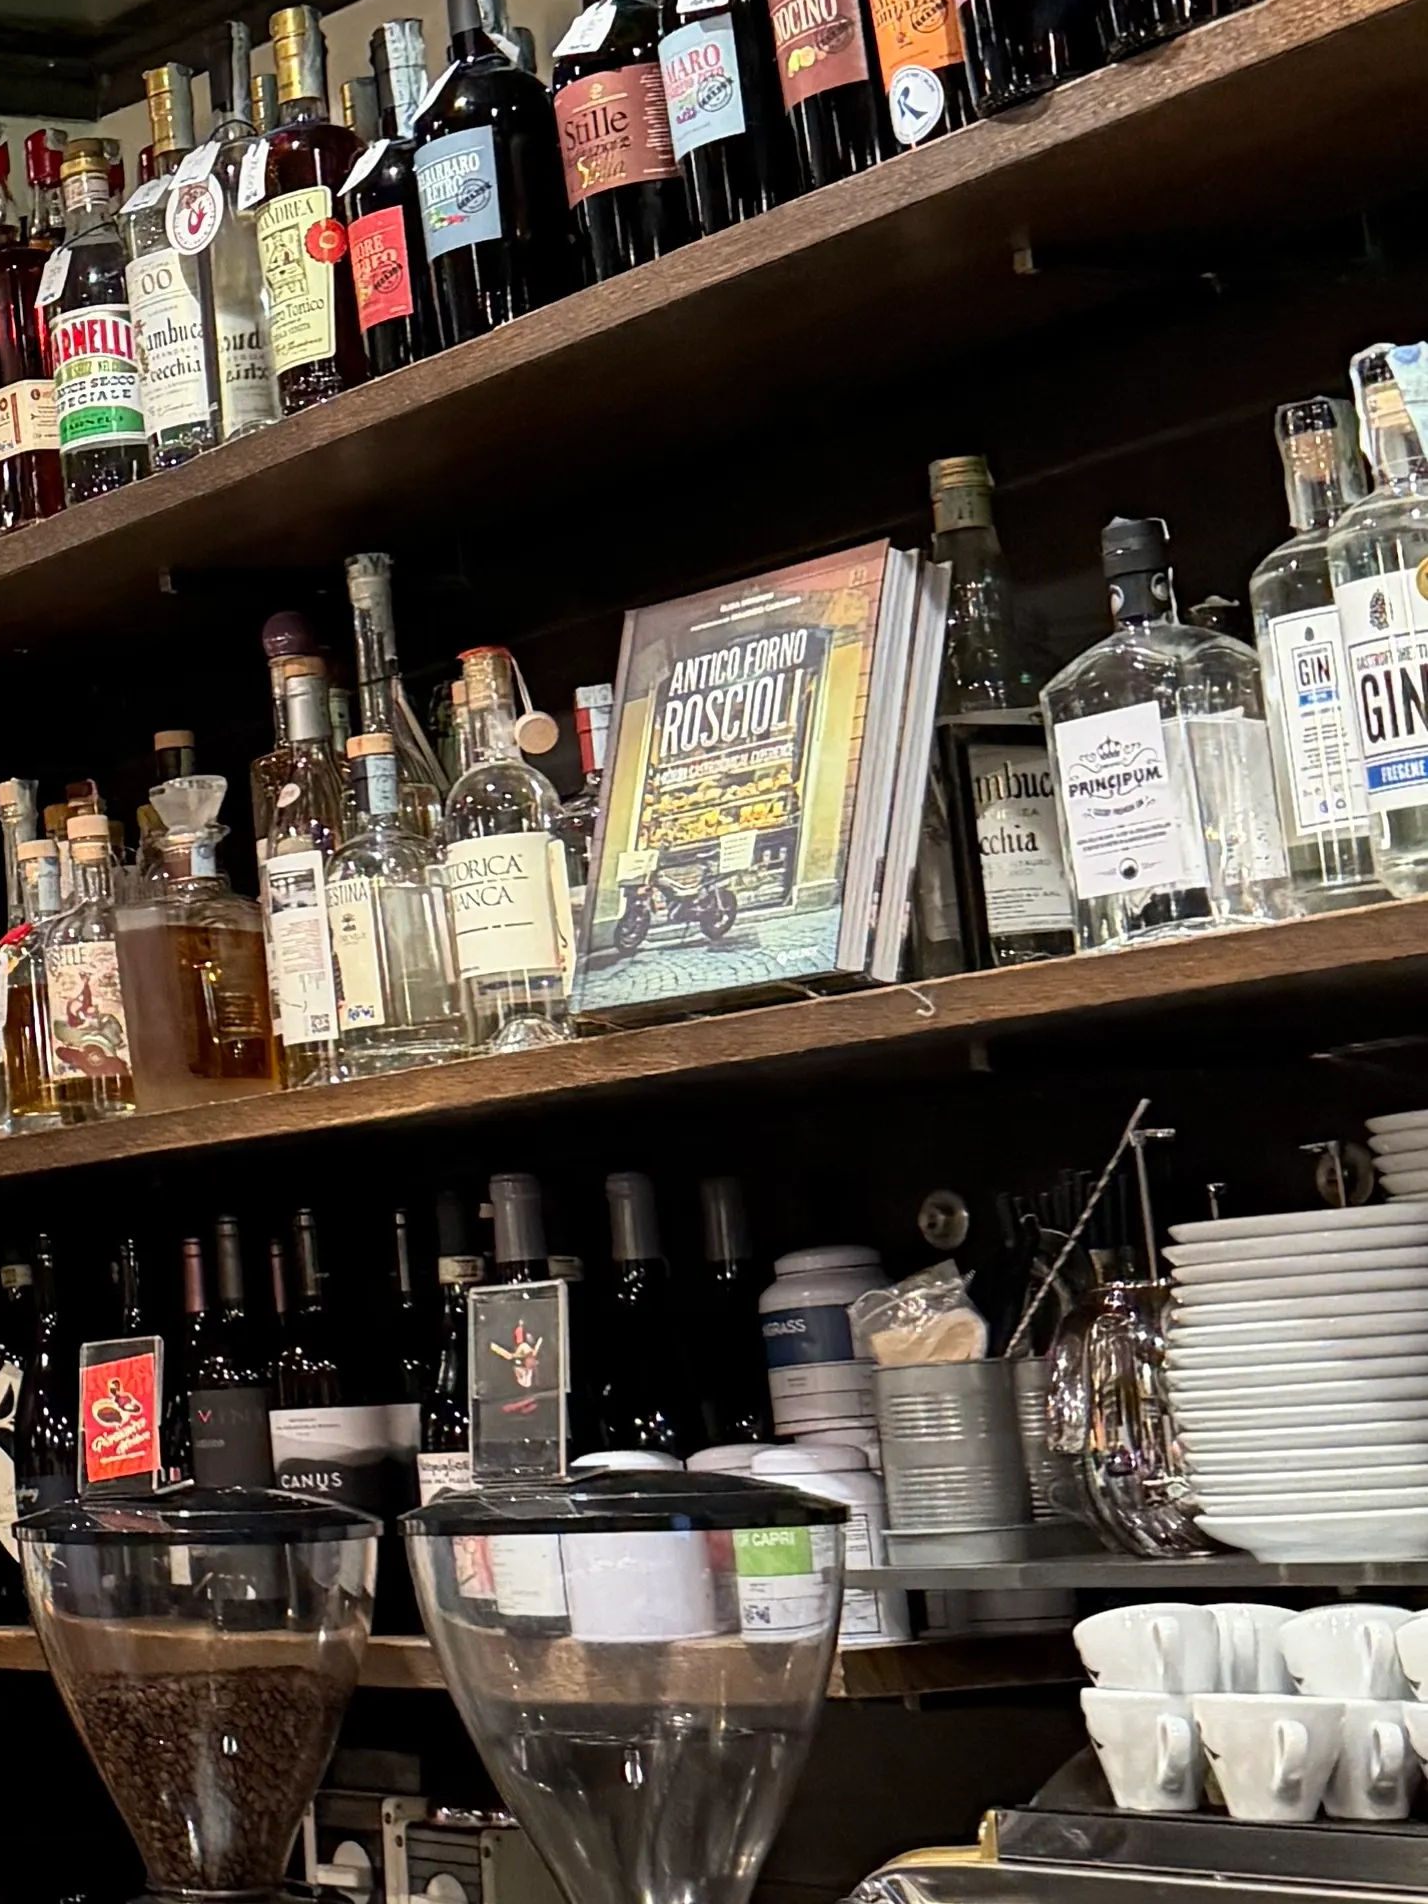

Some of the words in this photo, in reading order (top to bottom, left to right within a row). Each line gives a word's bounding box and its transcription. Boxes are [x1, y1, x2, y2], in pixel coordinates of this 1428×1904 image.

[665, 43, 721, 86] MARO
[564, 106, 630, 152] Stille
[141, 268, 173, 295] 00
[52, 319, 134, 369] ARNELLI
[145, 318, 204, 352] ambuca
[143, 356, 202, 383] ecchia
[669, 646, 740, 697] ANTICO
[744, 628, 808, 678] FORNO
[1297, 654, 1331, 687] GIN
[659, 667, 805, 758] ROSCIOLI
[1360, 661, 1428, 745] GIN
[974, 759, 1054, 805] mbuc
[1067, 763, 1164, 799] PRINCIPUM
[979, 824, 1039, 857] cchia
[280, 1471, 343, 1493] CANUS
[752, 1530, 795, 1547] CAPRI
